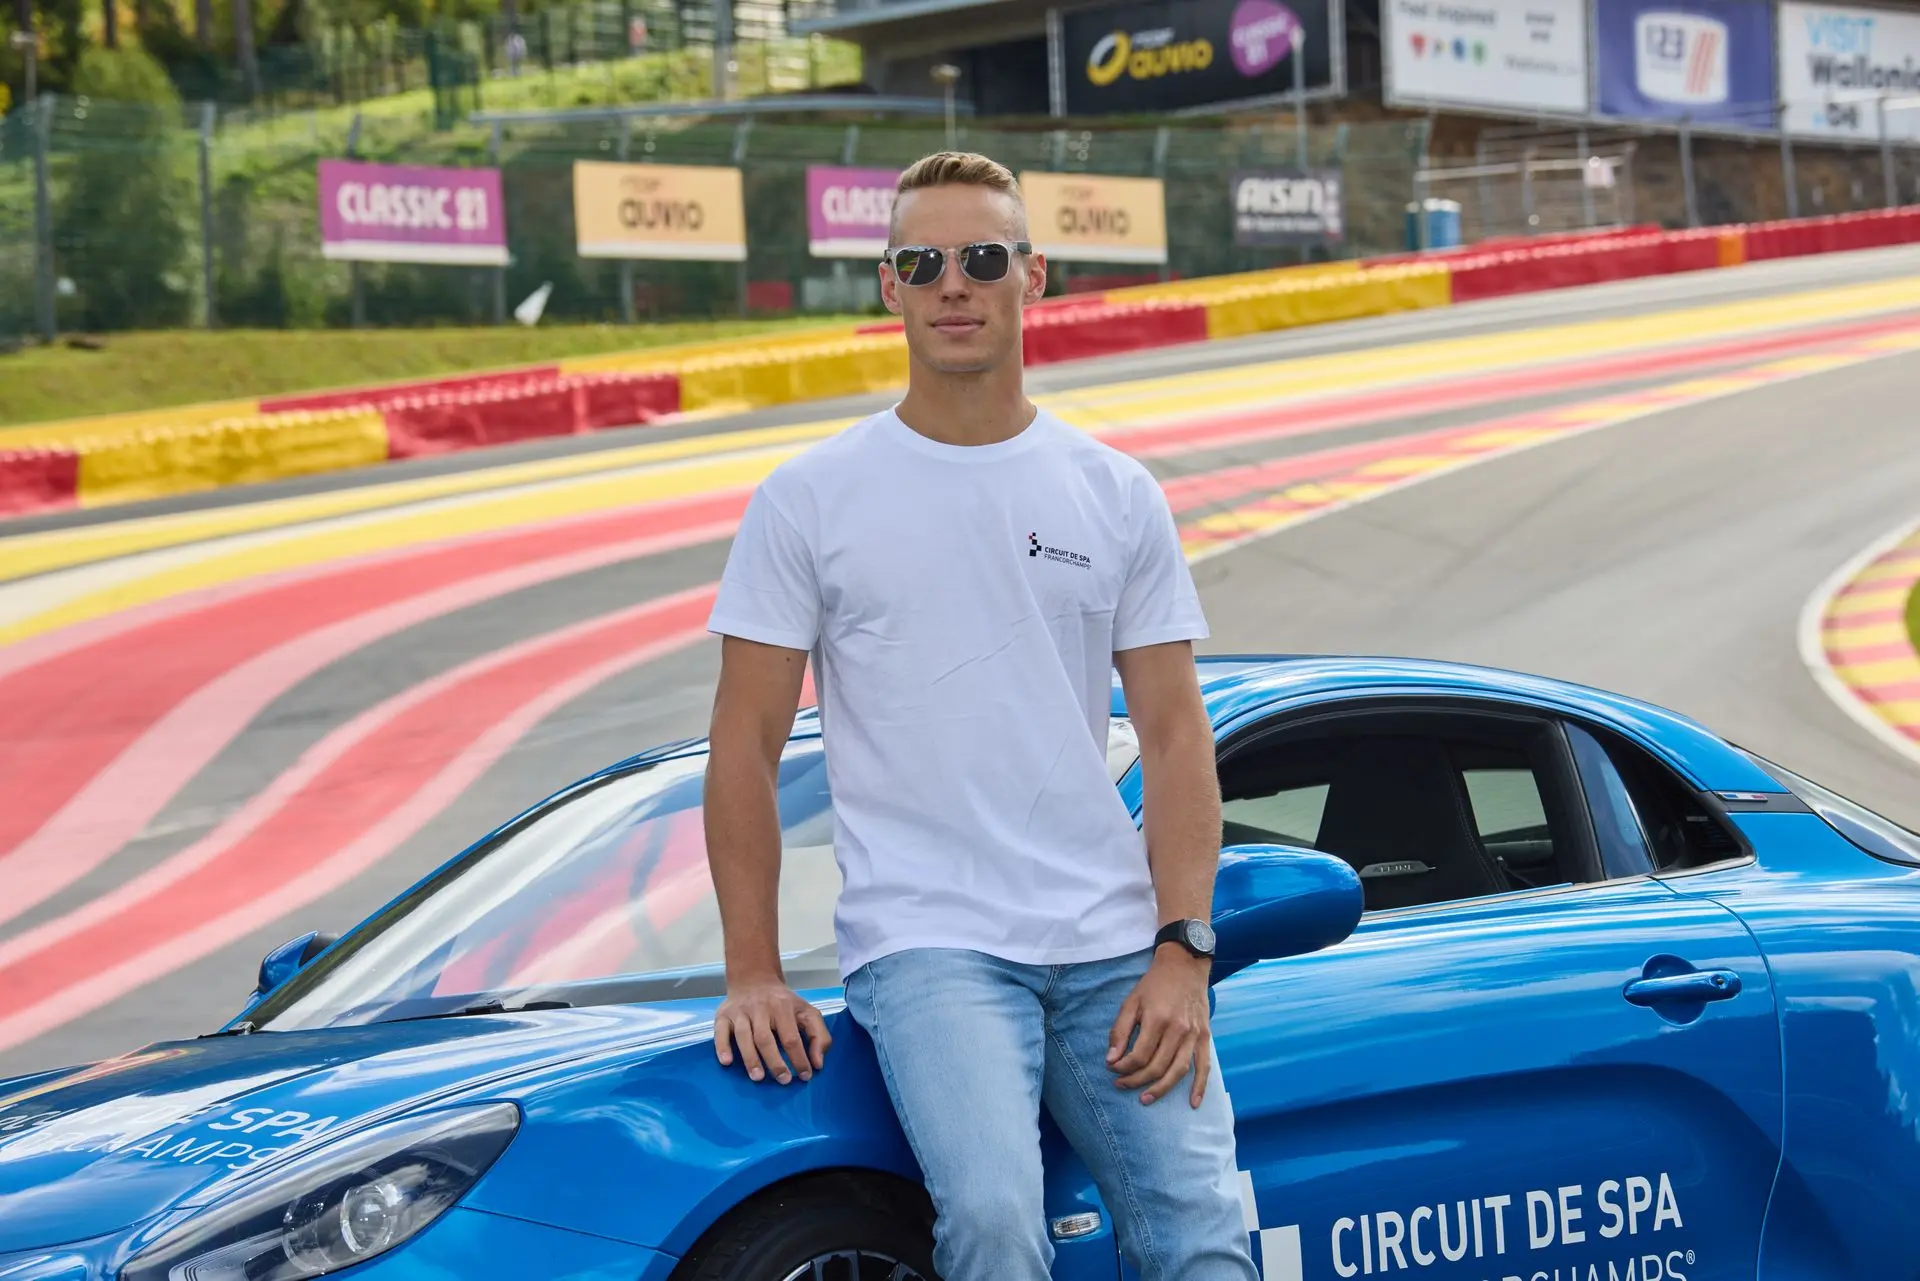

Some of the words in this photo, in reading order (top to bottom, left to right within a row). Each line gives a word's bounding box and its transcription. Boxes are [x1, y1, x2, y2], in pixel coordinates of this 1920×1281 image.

[1803, 11, 1876, 52] VISIT
[336, 181, 454, 229] CLASSIC
[455, 187, 488, 231] 21
[1044, 546, 1069, 558] CIRCUIT
[1069, 552, 1078, 560] DE
[1079, 554, 1091, 564] SPA
[208, 1107, 339, 1141] SPA
[1331, 1195, 1511, 1278] CIRCUIT
[1526, 1184, 1586, 1250] DE
[1597, 1172, 1683, 1238] SPA
